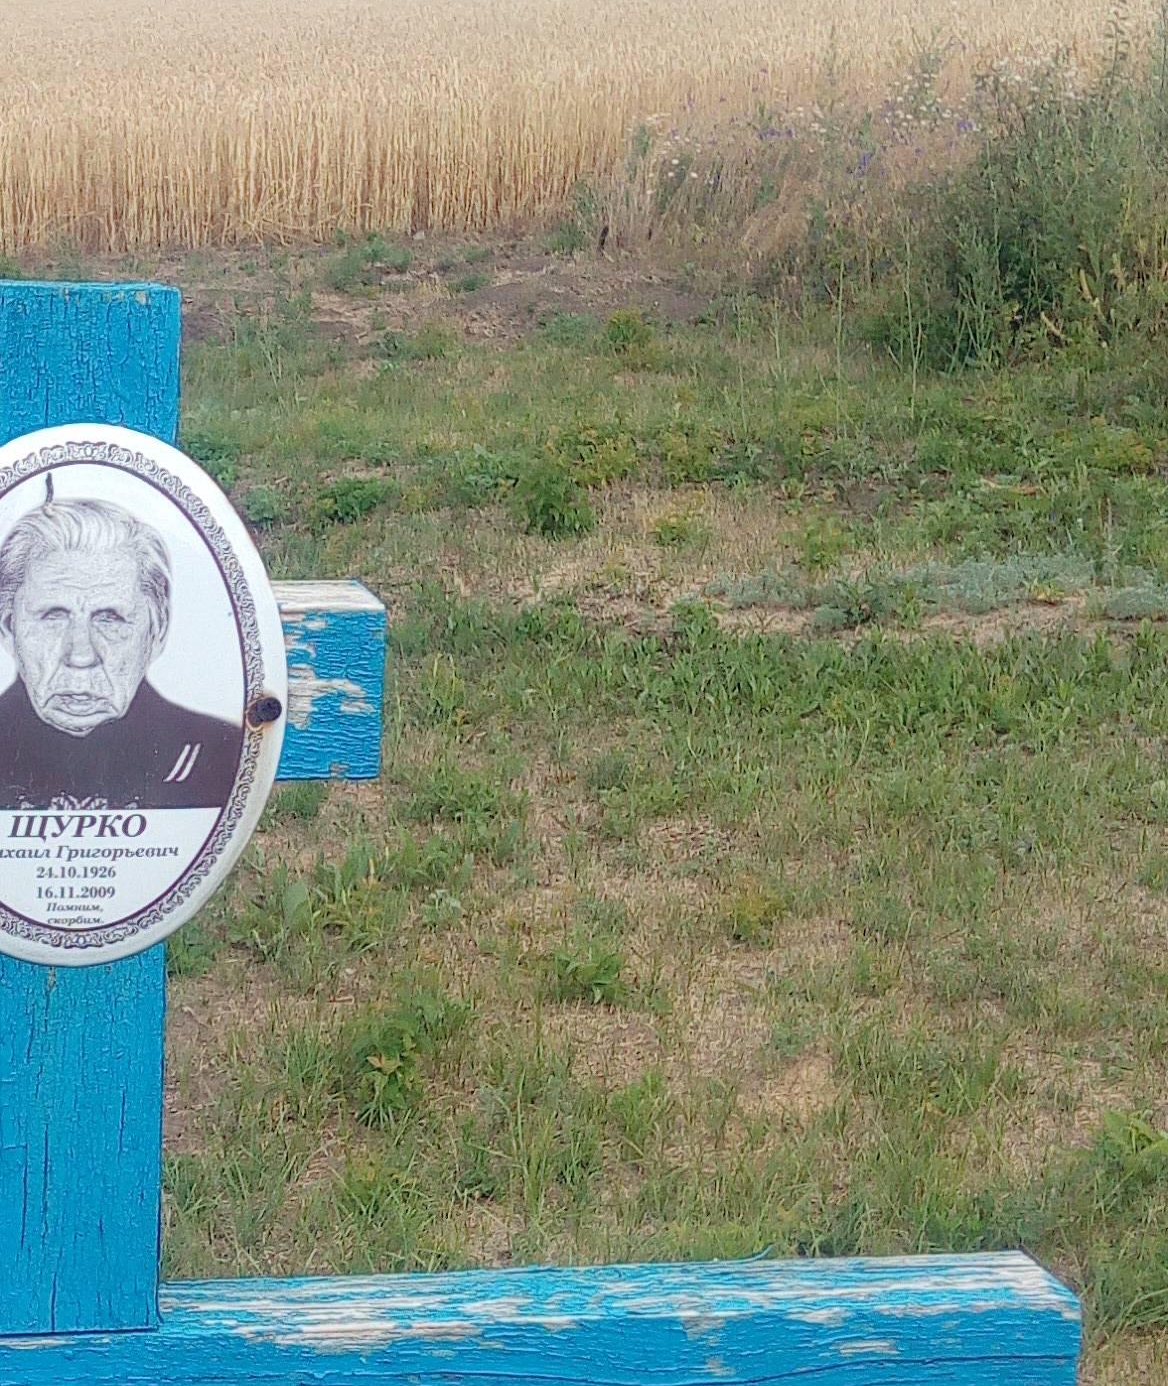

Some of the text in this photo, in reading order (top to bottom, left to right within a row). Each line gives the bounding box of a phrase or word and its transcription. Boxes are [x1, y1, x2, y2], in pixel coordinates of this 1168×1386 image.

[8, 814, 147, 842] ЩУРКО
[56, 846, 179, 862] Григорьевич
[36, 866, 116, 878] 24.10.1926
[36, 887, 115, 898] 16.11.2009
